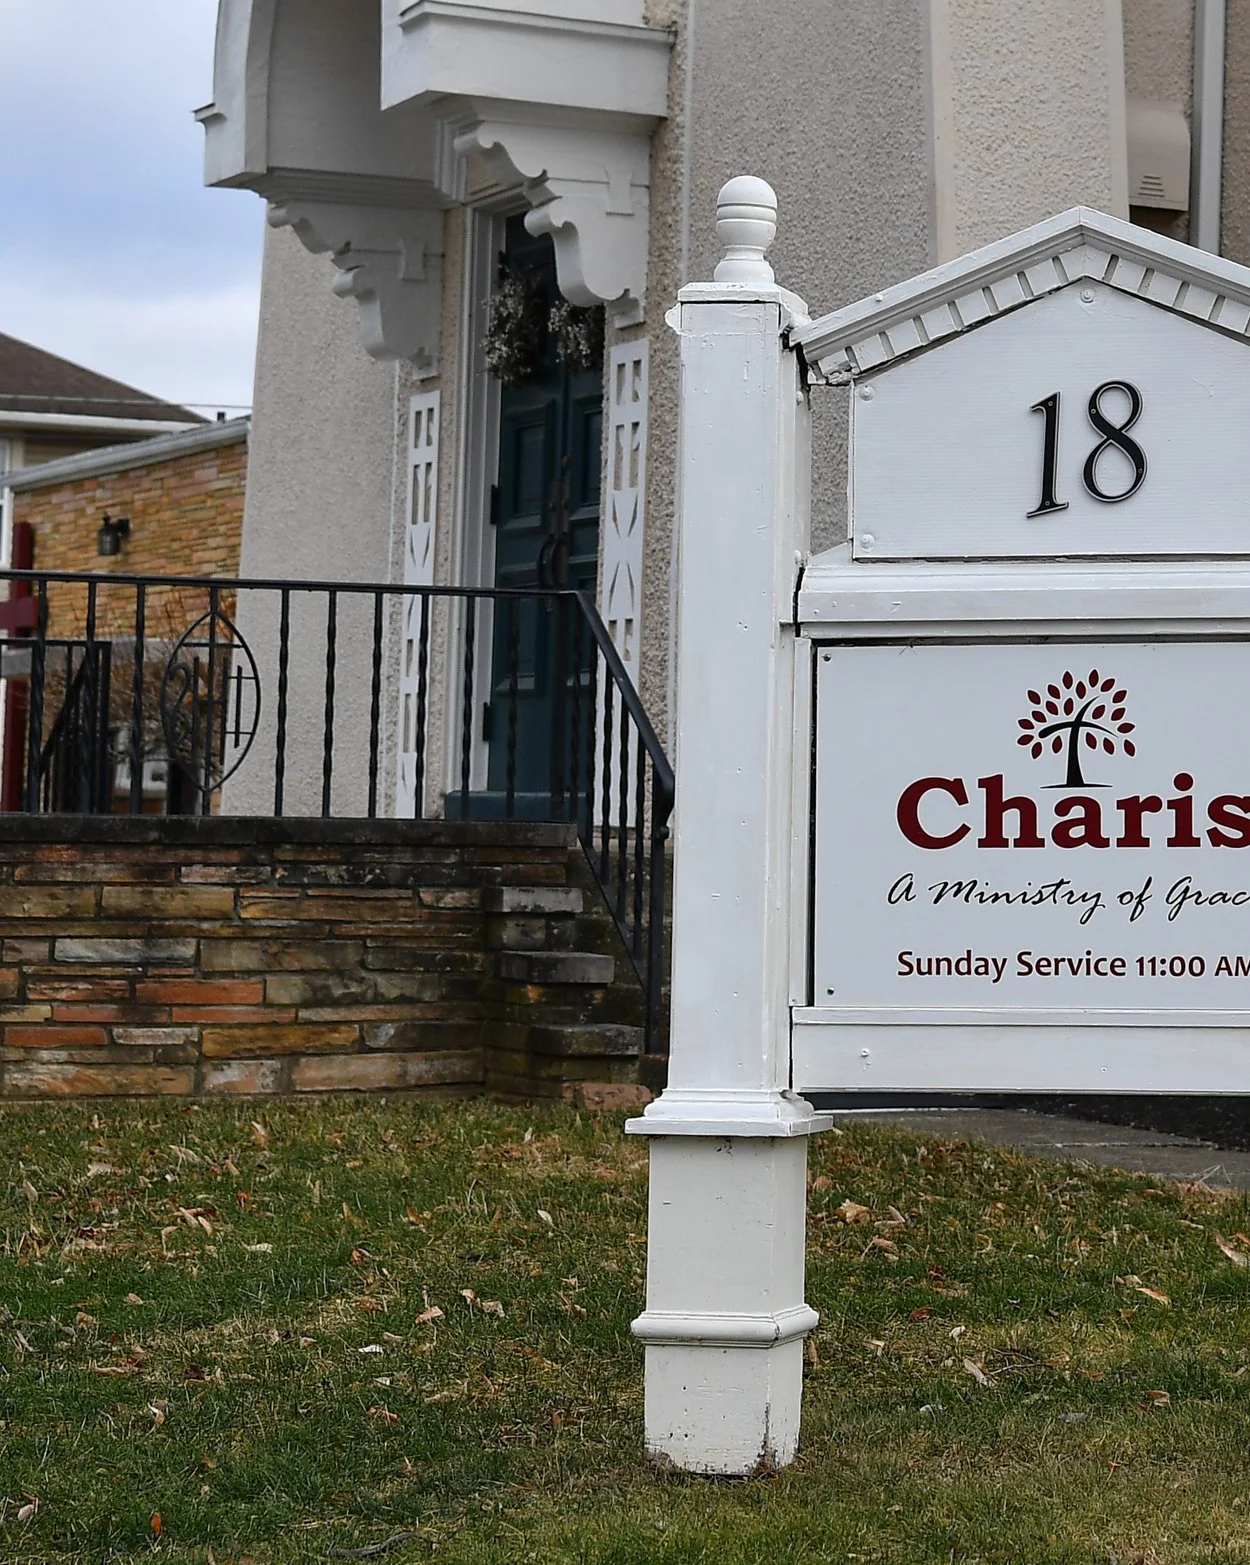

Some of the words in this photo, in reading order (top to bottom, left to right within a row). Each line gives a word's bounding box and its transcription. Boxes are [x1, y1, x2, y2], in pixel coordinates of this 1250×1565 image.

[1026, 380, 1148, 518] 18
[888, 873, 916, 904] A
[929, 879, 1105, 924] Ministry
[1117, 876, 1152, 922] of
[898, 950, 1007, 983] Sunday
[1017, 950, 1126, 976] Service
[1136, 956, 1205, 976] 11:00
